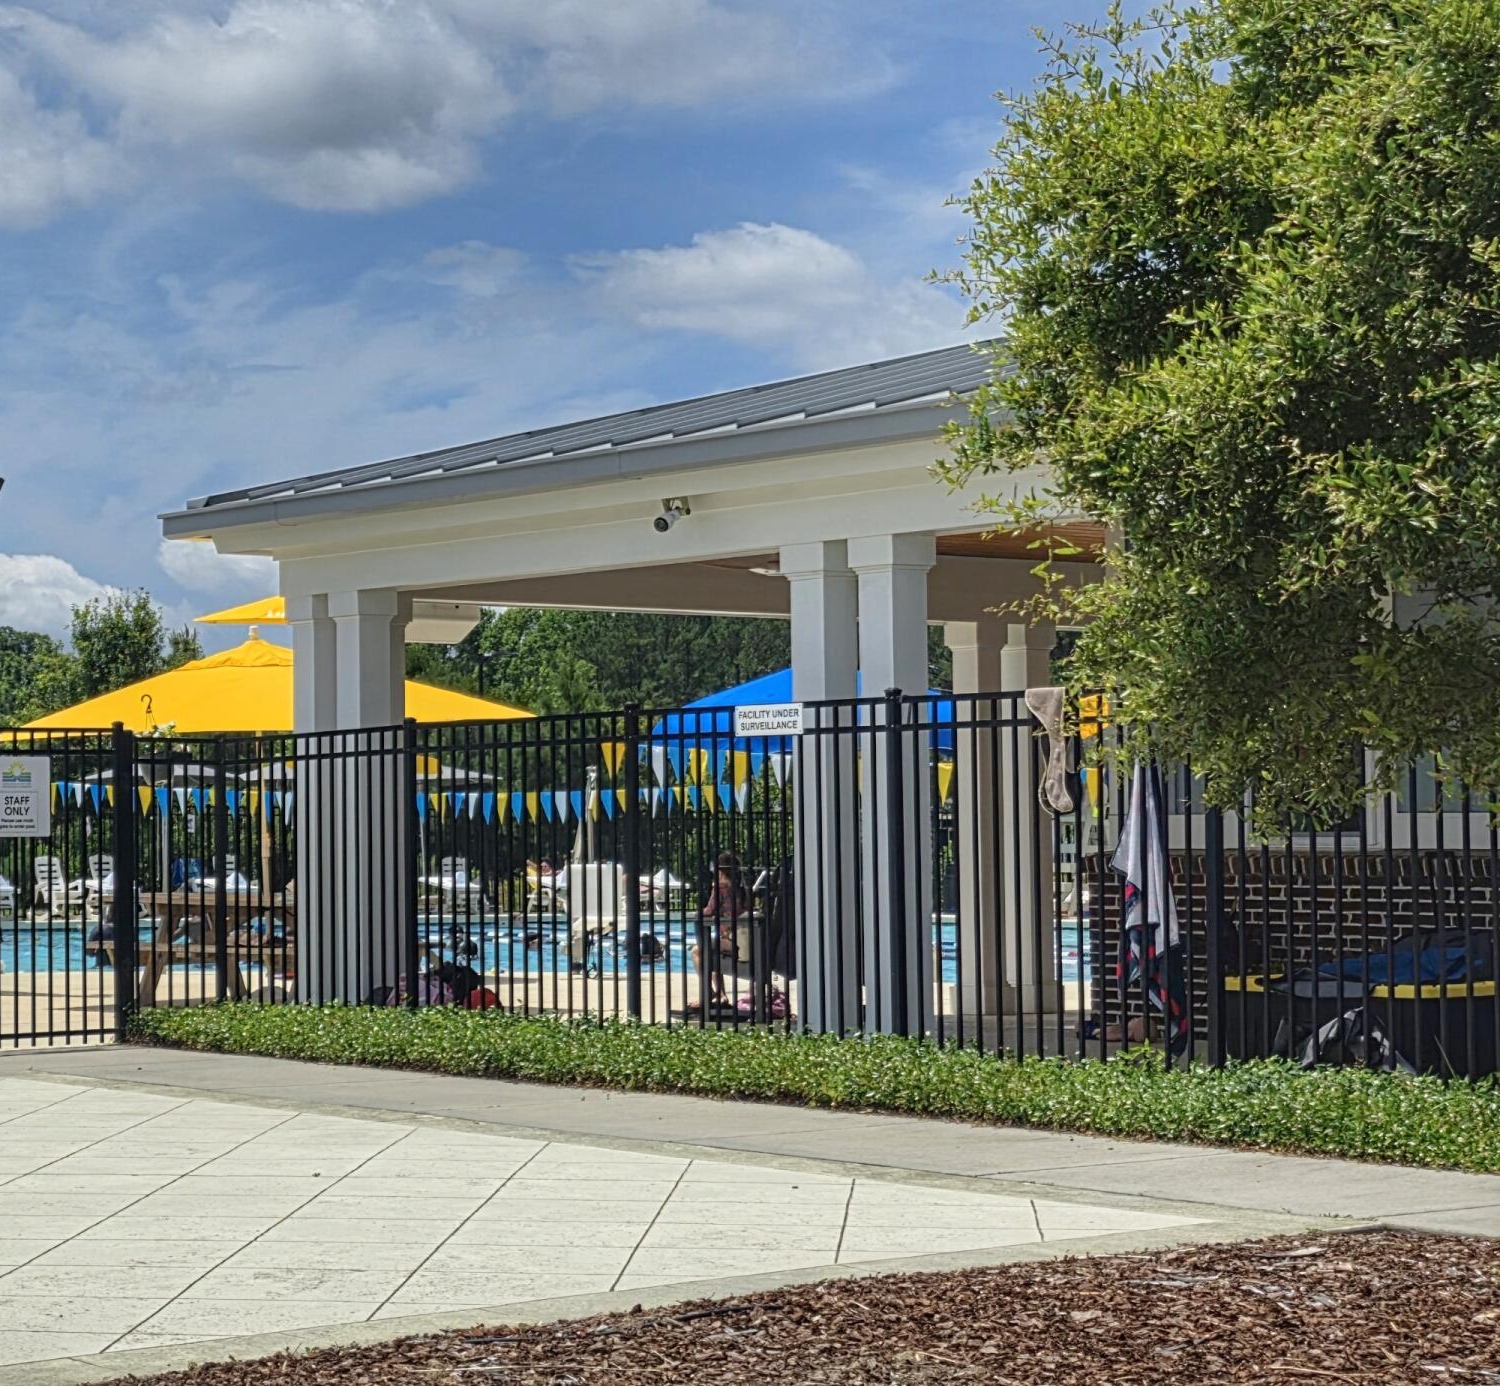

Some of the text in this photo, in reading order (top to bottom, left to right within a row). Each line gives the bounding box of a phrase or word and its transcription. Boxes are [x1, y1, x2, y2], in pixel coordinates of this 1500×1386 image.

[738, 708, 799, 719] FACILITY UNDER
[740, 720, 798, 731] SURVEILLANCE
[4, 796, 30, 805] STAFF
[4, 806, 30, 816] ONLY
